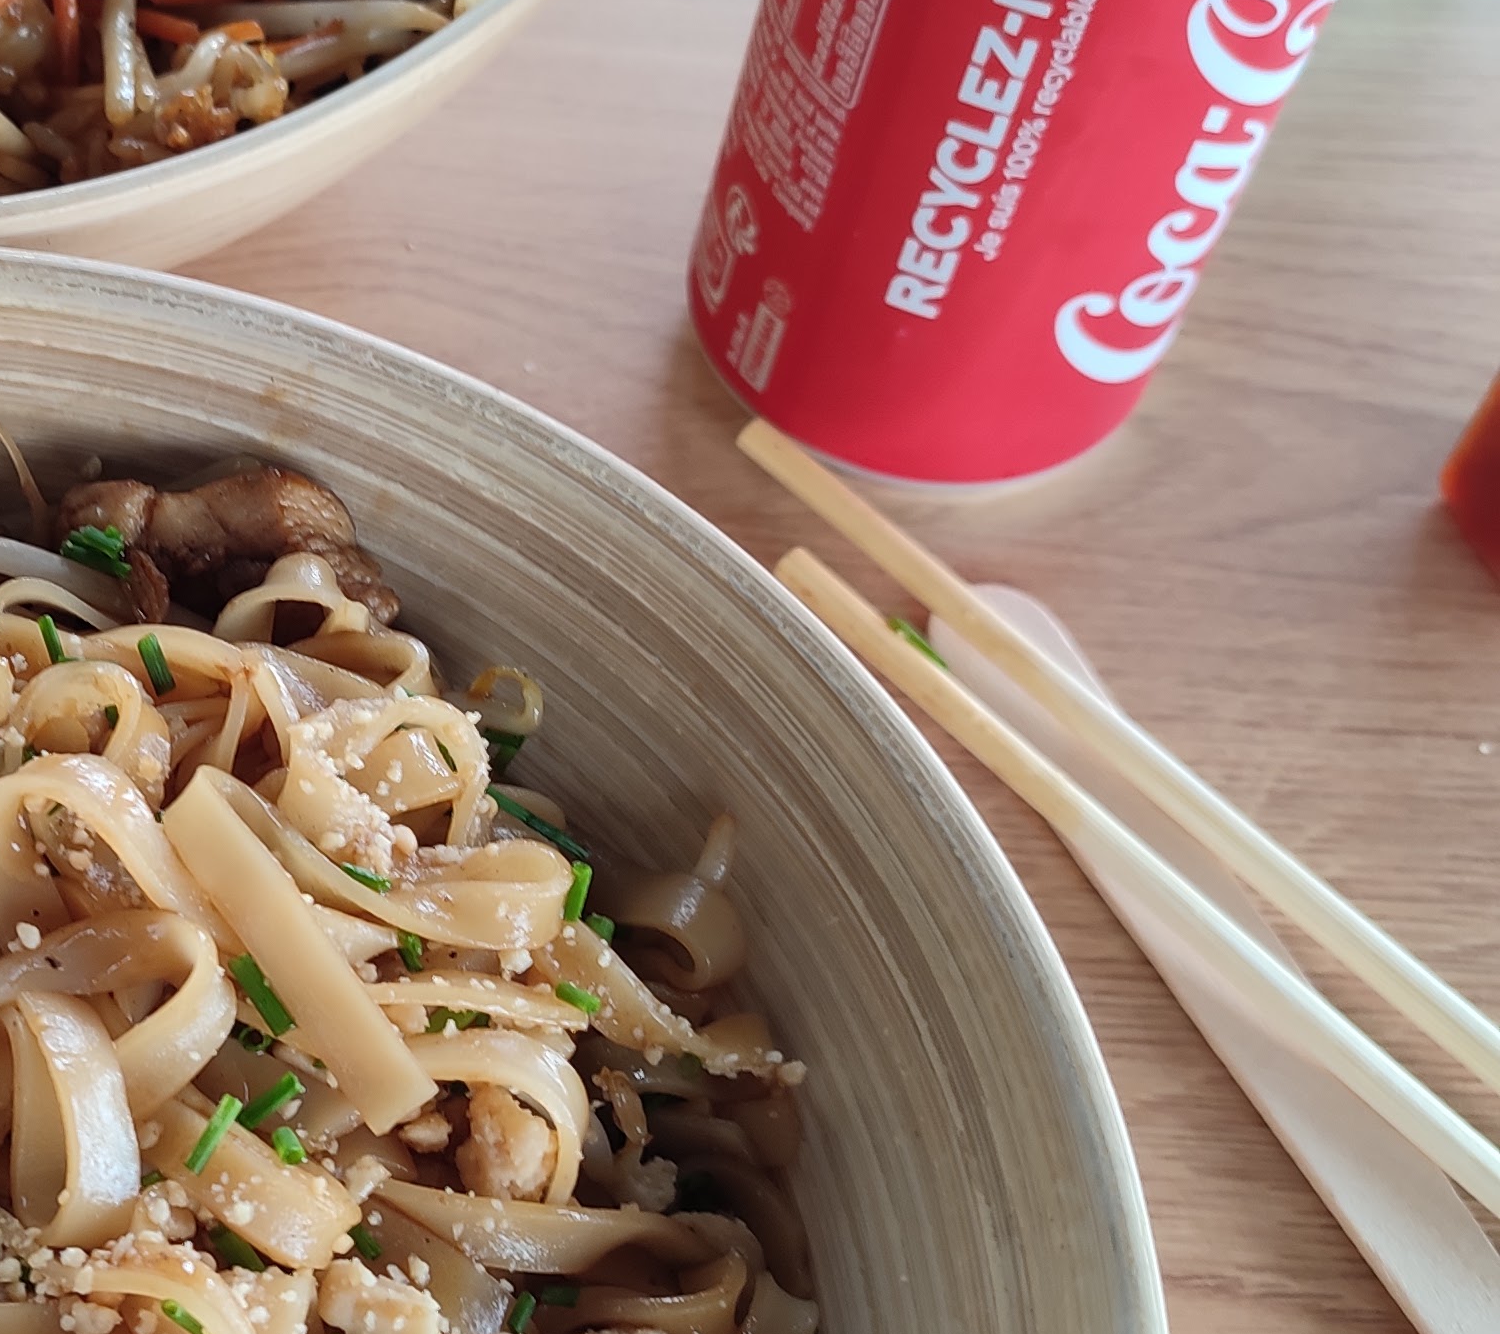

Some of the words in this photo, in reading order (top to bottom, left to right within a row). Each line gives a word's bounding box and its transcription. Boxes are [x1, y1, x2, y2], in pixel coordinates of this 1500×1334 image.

[1002, 115, 1048, 181] 100%
[987, 181, 1023, 231] suis
[974, 230, 1003, 262] Je
